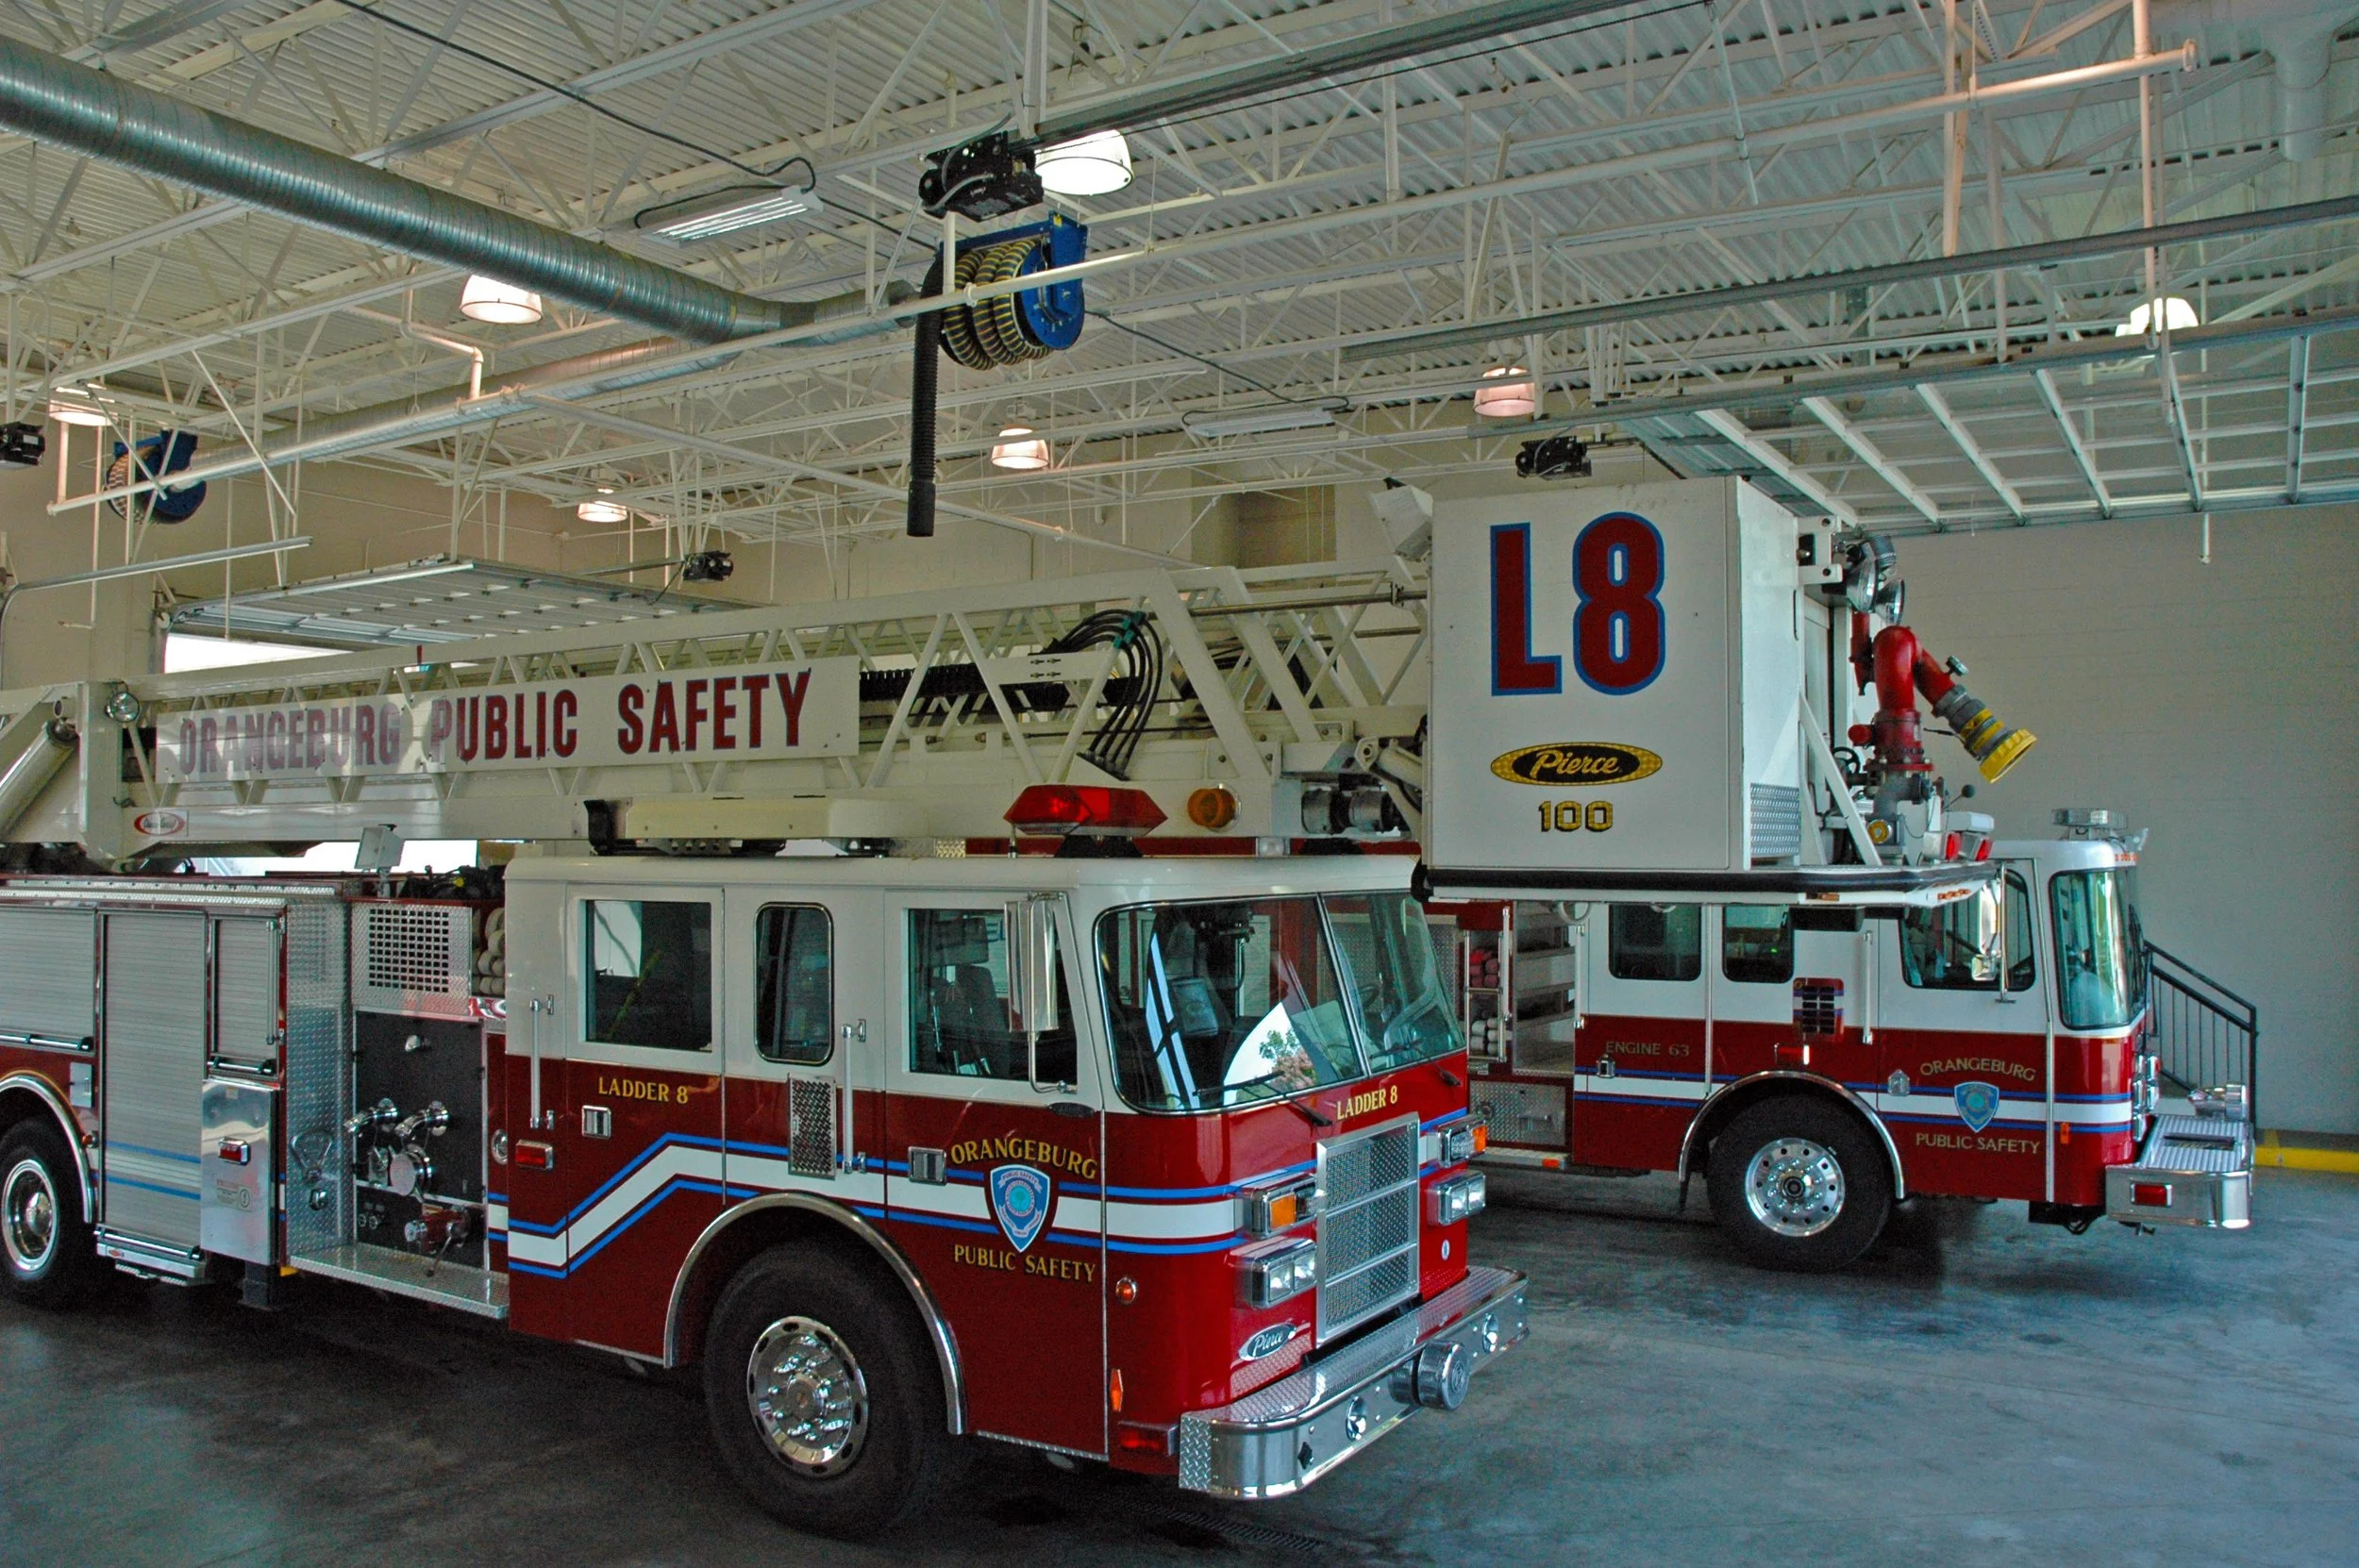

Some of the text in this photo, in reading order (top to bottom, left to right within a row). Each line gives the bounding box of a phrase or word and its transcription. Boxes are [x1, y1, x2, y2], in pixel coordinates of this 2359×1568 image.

[1490, 511, 1666, 696] L8
[179, 670, 811, 775] ORANGEBURG PUBLIC SAFETY
[1529, 749, 1620, 779] Pierce
[1538, 800, 1614, 832] 100
[1605, 1041, 1690, 1057] ENGINE 63
[1919, 1057, 2037, 1081] ORANGEBURG
[598, 1076, 689, 1104] LADDER 8
[1336, 1084, 1398, 1121] LADDER 8
[950, 1138, 1099, 1179] ORANGEBURG
[1916, 1132, 2041, 1154] PUBLIC SAFETY
[954, 1243, 1096, 1283] PUBLIC SAFETY
[1252, 1330, 1284, 1357] Pierce
